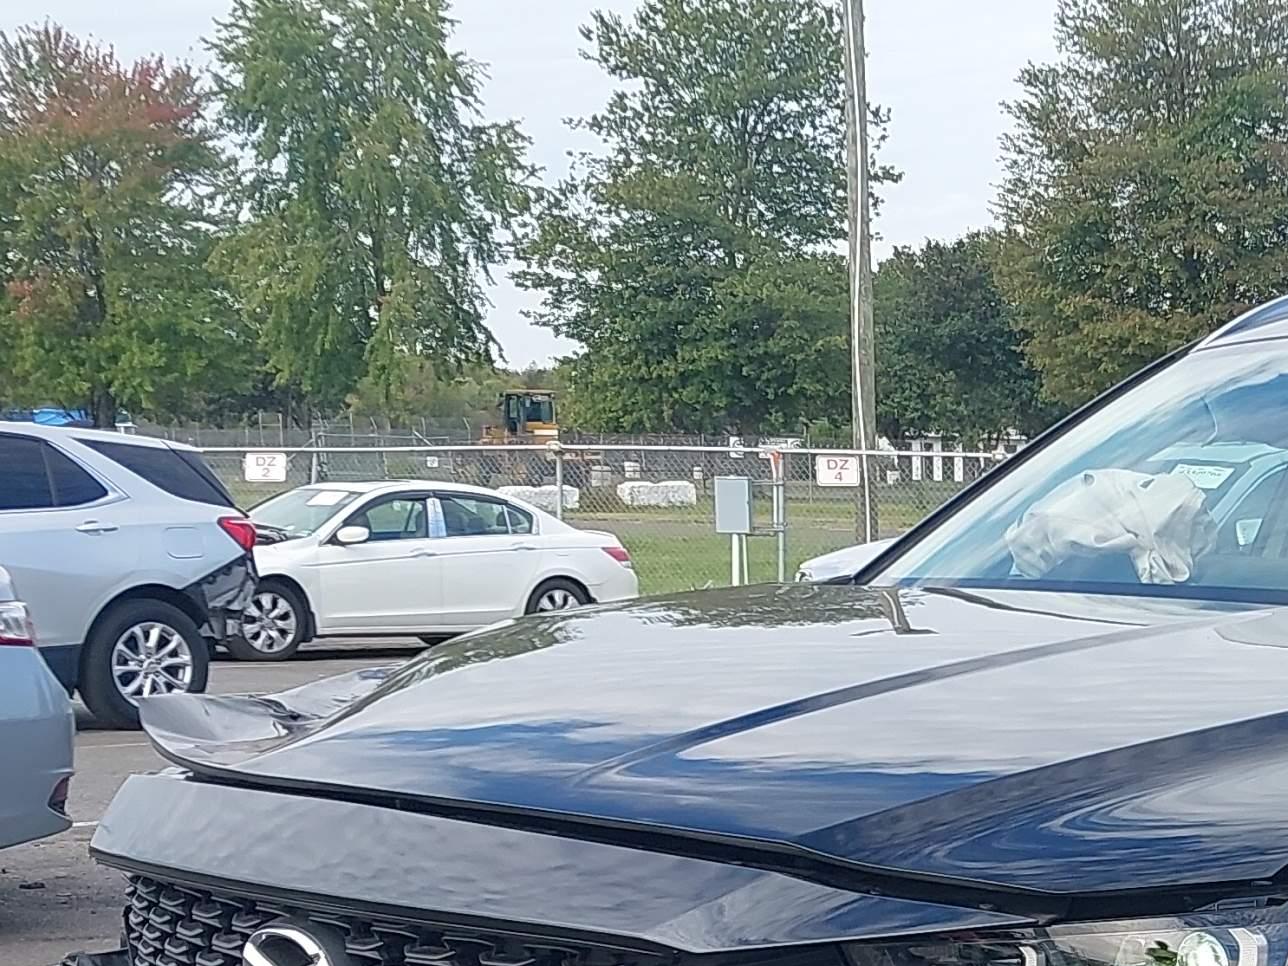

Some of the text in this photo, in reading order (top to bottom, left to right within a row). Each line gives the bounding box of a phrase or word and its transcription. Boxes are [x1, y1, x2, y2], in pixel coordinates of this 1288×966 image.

[256, 456, 277, 466] DZ
[826, 459, 850, 470] DZ
[261, 468, 270, 477] 2
[834, 471, 843, 481] 4
